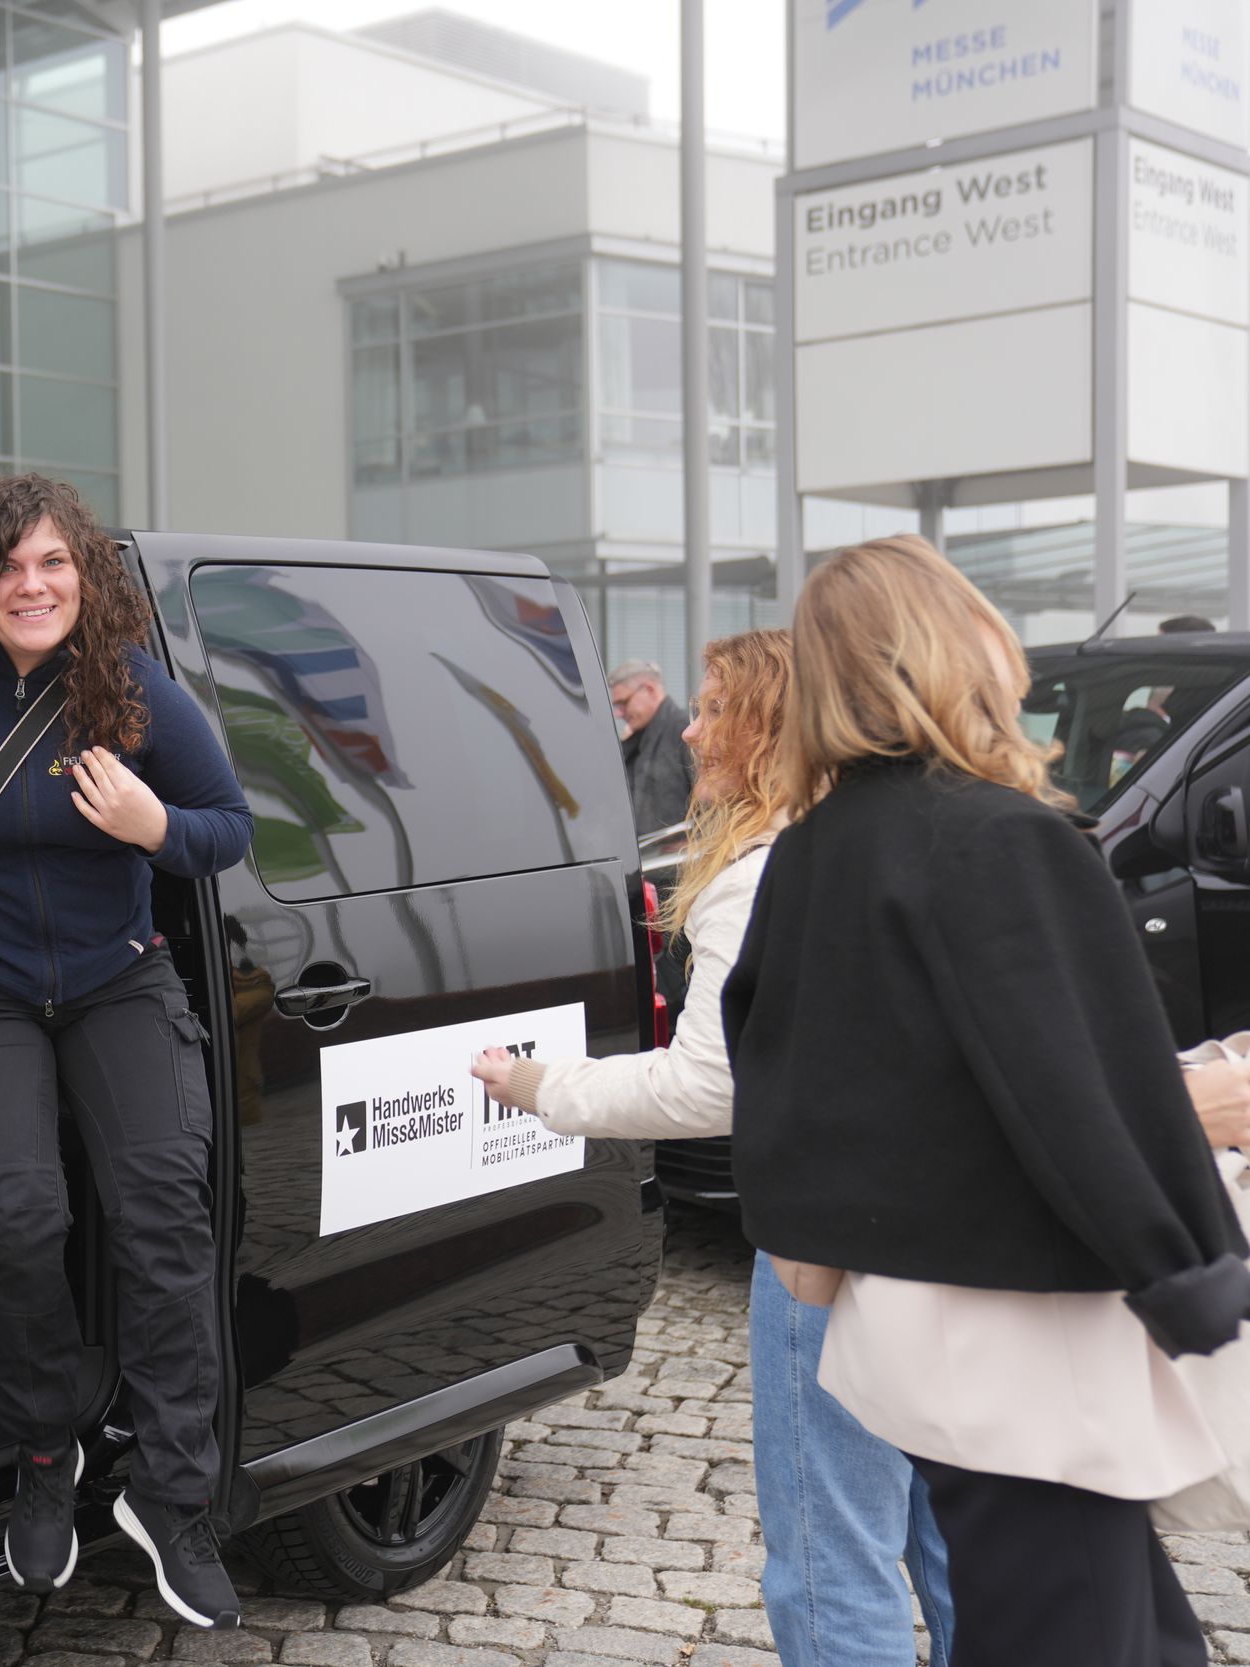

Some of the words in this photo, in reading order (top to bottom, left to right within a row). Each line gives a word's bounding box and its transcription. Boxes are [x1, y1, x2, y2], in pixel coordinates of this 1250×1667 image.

[912, 25, 1007, 67] MESSE
[911, 49, 1062, 101] MÜNCHEN
[806, 189, 942, 233] Eingang
[957, 164, 1048, 202] West
[1134, 155, 1194, 204] Eingang
[1198, 177, 1235, 214] West
[806, 230, 952, 276] Entrance
[964, 208, 1055, 247] West
[1134, 201, 1198, 246] Entrance
[1200, 222, 1237, 257] West
[372, 1085, 455, 1121] Handwerks
[372, 1112, 464, 1149] Miss&Mister
[482, 1130, 537, 1152] OFFIZIELLER
[483, 1117, 538, 1133] PROFESSIONAL
[481, 1135, 575, 1167] MOBILITÄTSPARTNER
